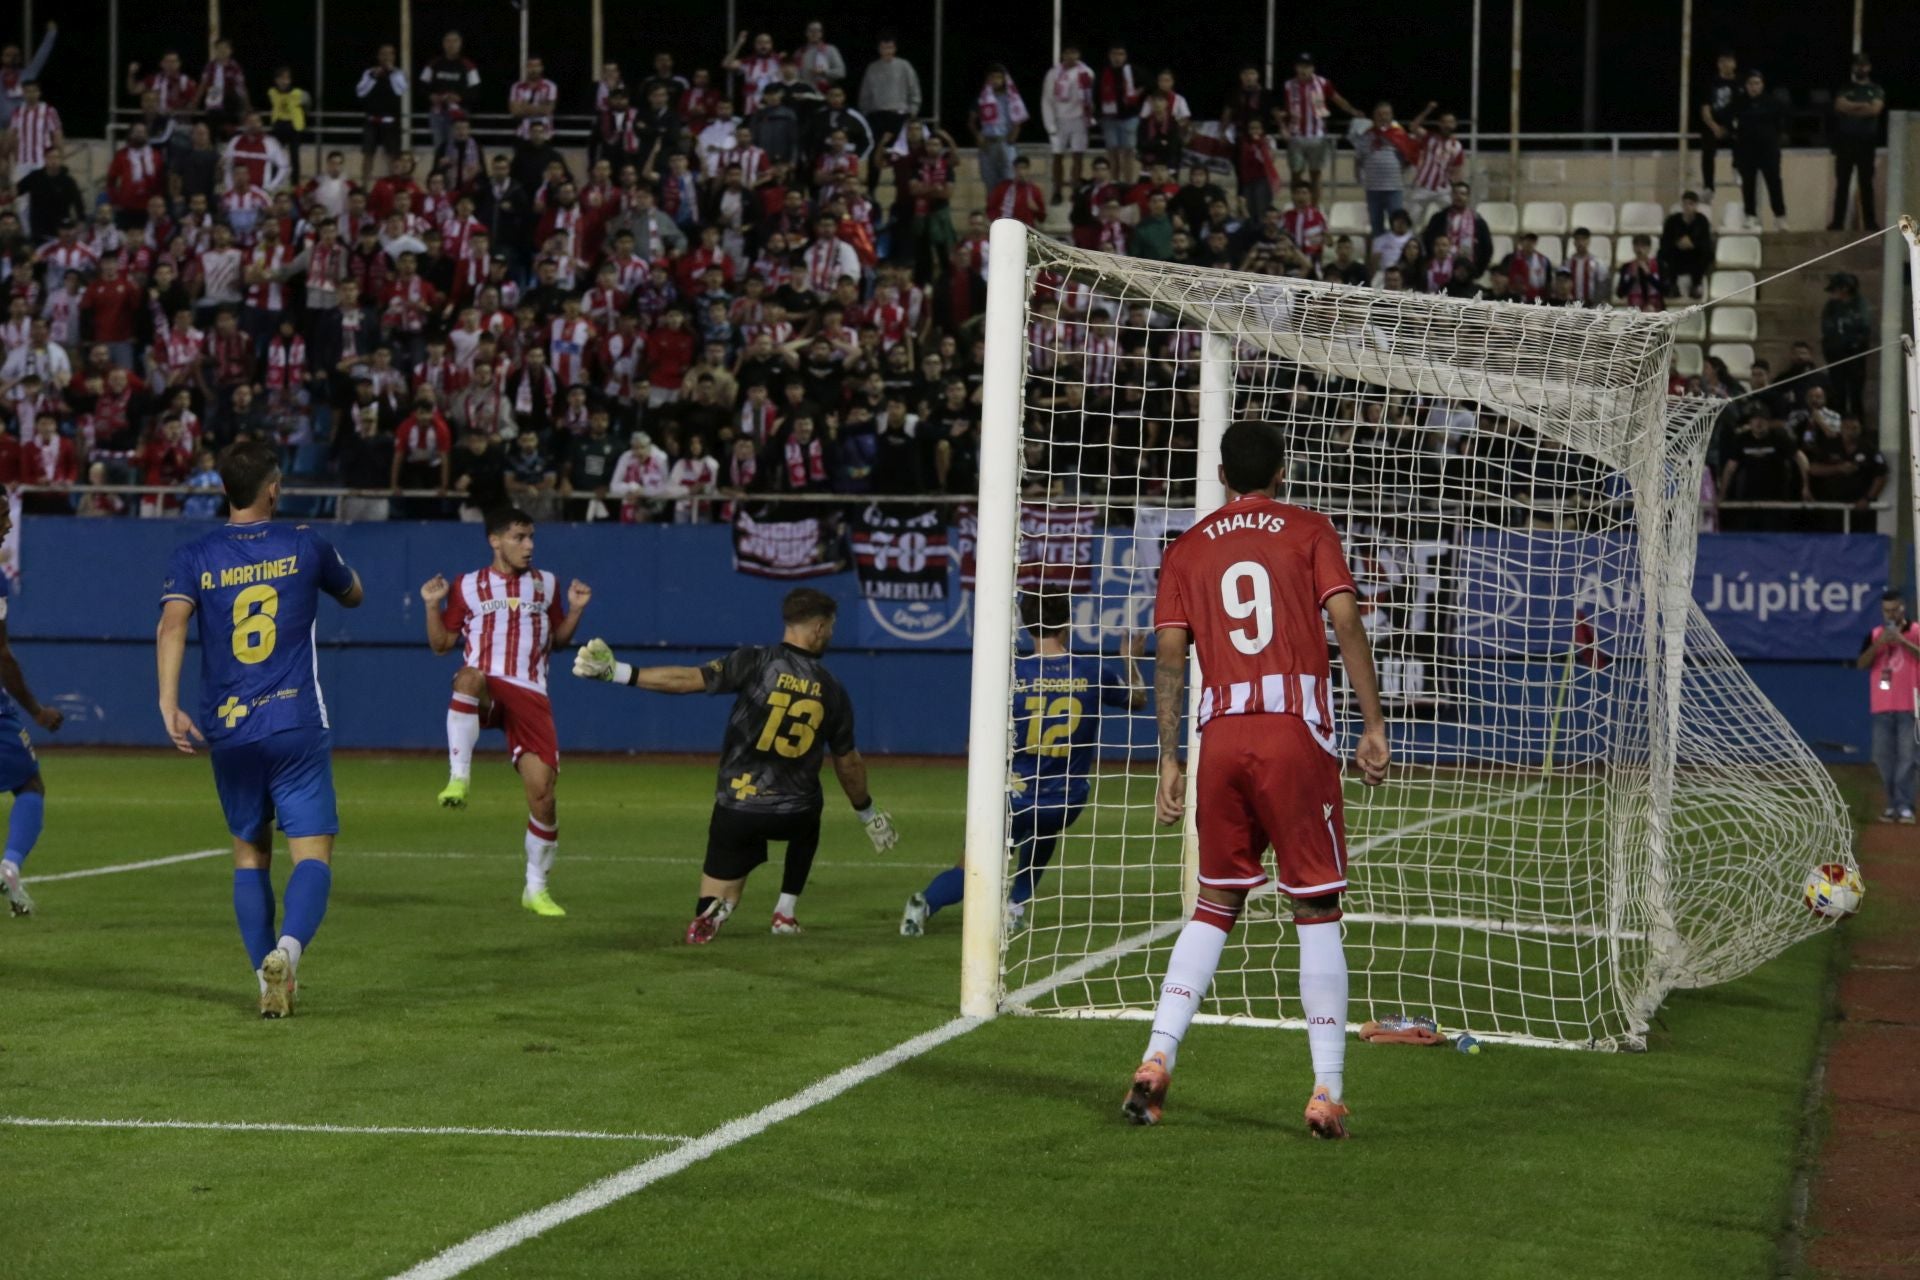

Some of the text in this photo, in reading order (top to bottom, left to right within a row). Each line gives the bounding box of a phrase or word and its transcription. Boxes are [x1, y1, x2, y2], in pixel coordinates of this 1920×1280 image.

[1202, 512, 1285, 541] THALYS
[870, 531, 928, 573] 78
[201, 555, 300, 591] A. MARTÍNEZ
[481, 597, 508, 614] KUDU
[864, 579, 944, 601] LMERIA
[1705, 570, 1871, 623] Júpiter
[1220, 560, 1274, 655] 9
[231, 583, 279, 665] 8
[776, 672, 809, 694] FRAN
[1032, 677, 1089, 693] ESCOBAR
[755, 691, 825, 759] 13
[1024, 696, 1083, 758] 12
[1165, 986, 1192, 999] UDA
[1308, 1016, 1337, 1026] UDA
